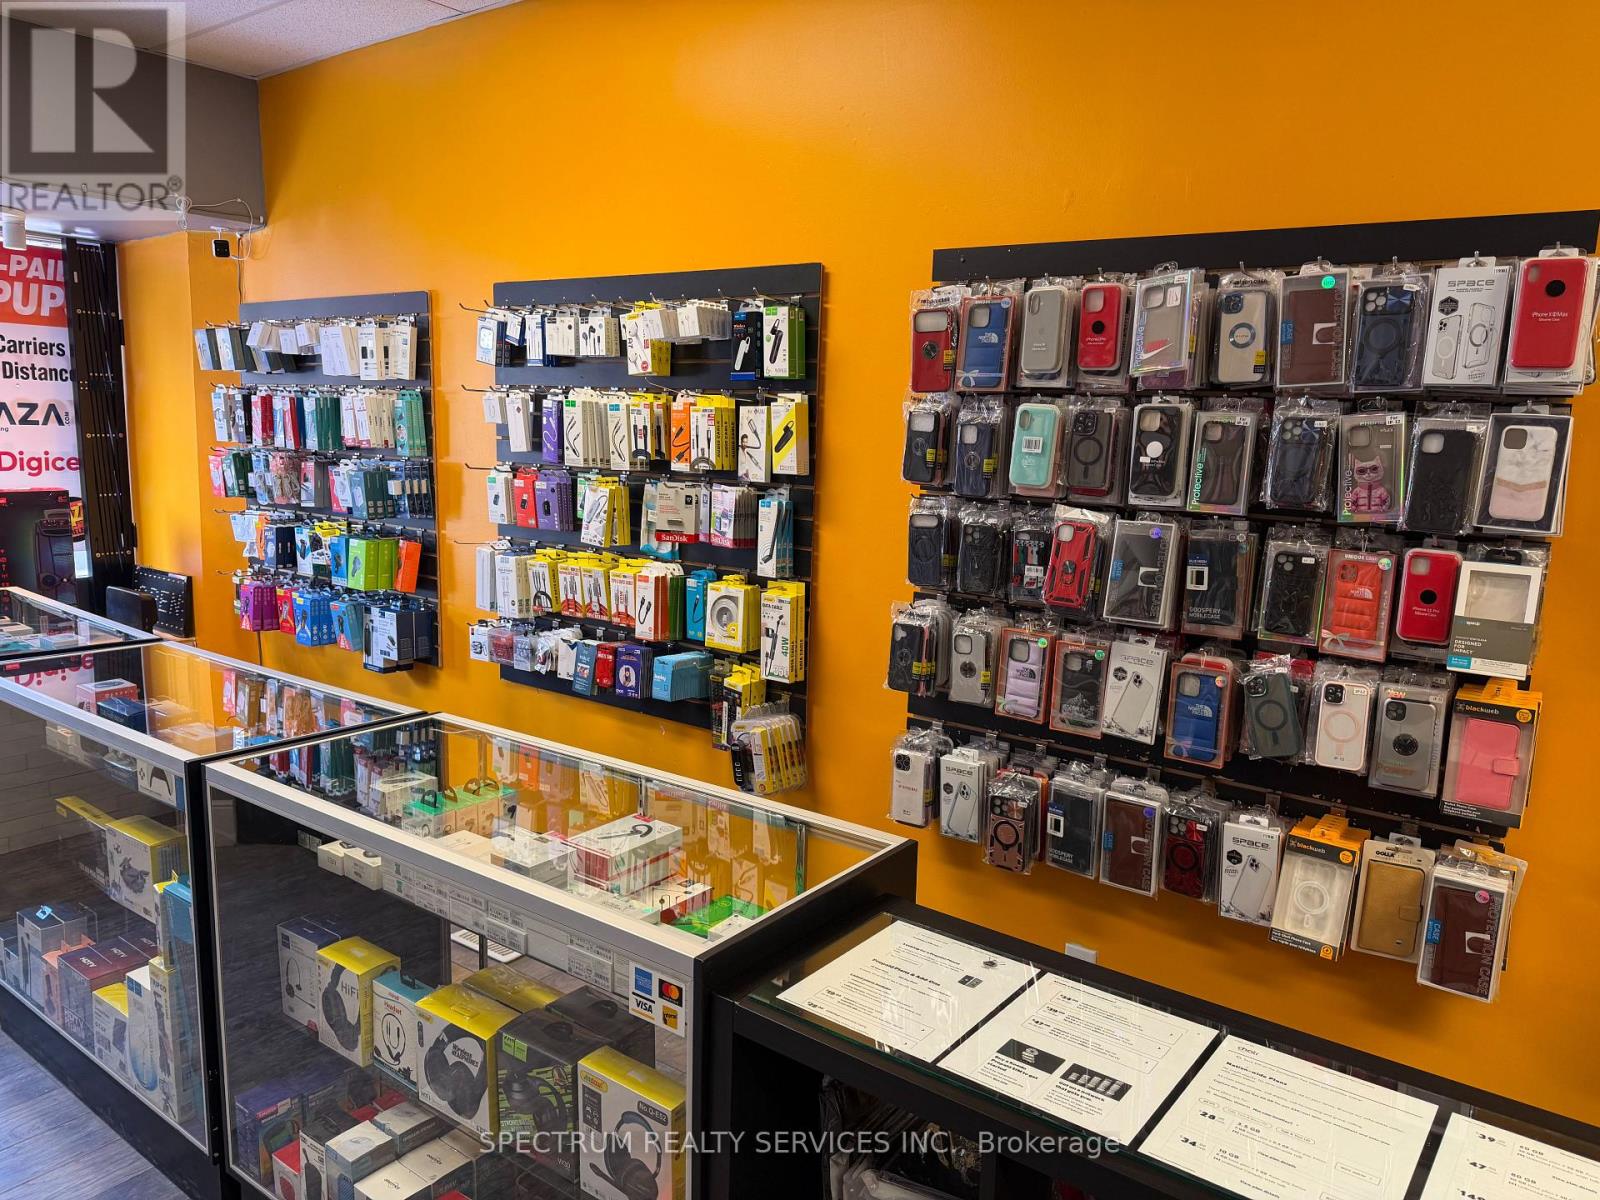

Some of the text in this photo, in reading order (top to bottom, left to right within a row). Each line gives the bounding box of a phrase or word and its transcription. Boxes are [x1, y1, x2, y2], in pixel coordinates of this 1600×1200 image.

[1191, 463, 1204, 505] Protective
[1342, 469, 1353, 516] Protective
[661, 534, 689, 543] SanDisk
[781, 636, 789, 657] 40W
[1454, 639, 1482, 648] DESIGNED
[1465, 704, 1500, 716] blackweb
[1296, 842, 1326, 855] blackweb
[79, 956, 97, 968] HDTV
[340, 983, 359, 999] HiFi
[635, 998, 653, 1014] VISA
[1268, 1076, 1288, 1086] Plans
